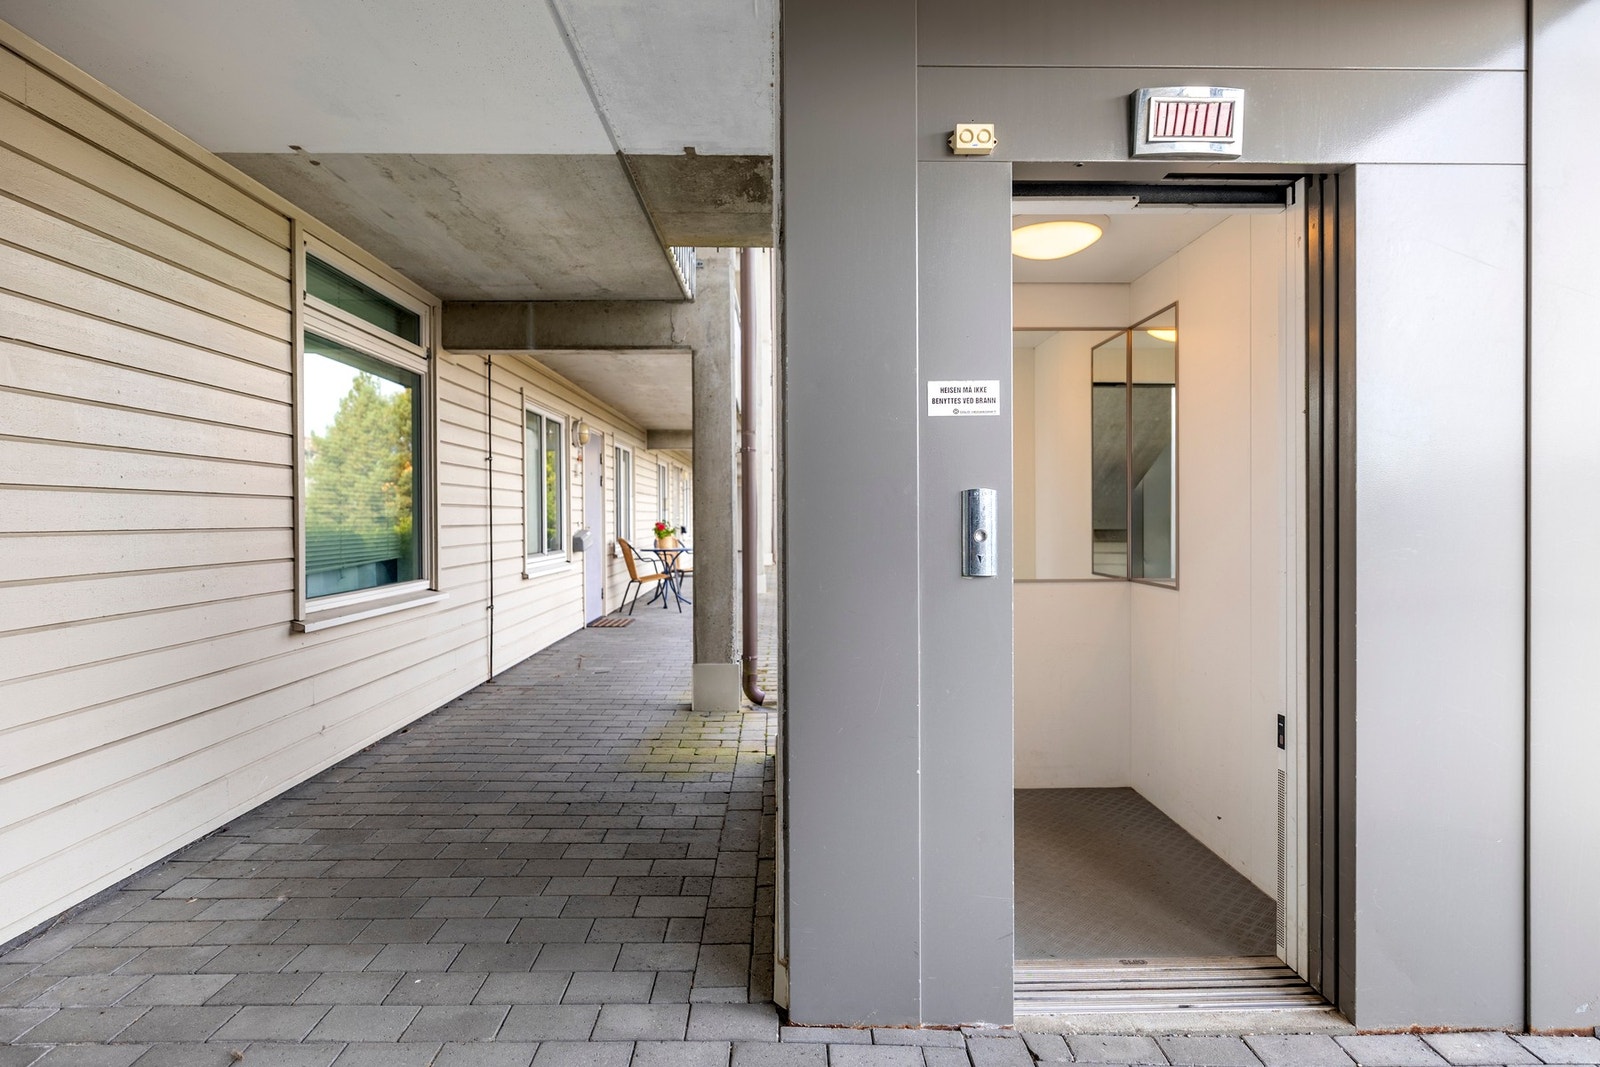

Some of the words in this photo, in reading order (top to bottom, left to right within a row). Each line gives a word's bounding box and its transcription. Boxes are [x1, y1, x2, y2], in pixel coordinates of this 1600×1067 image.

[940, 386, 961, 394] HEISEN
[973, 386, 987, 394] IKKE
[931, 397, 961, 405] BENYTTES
